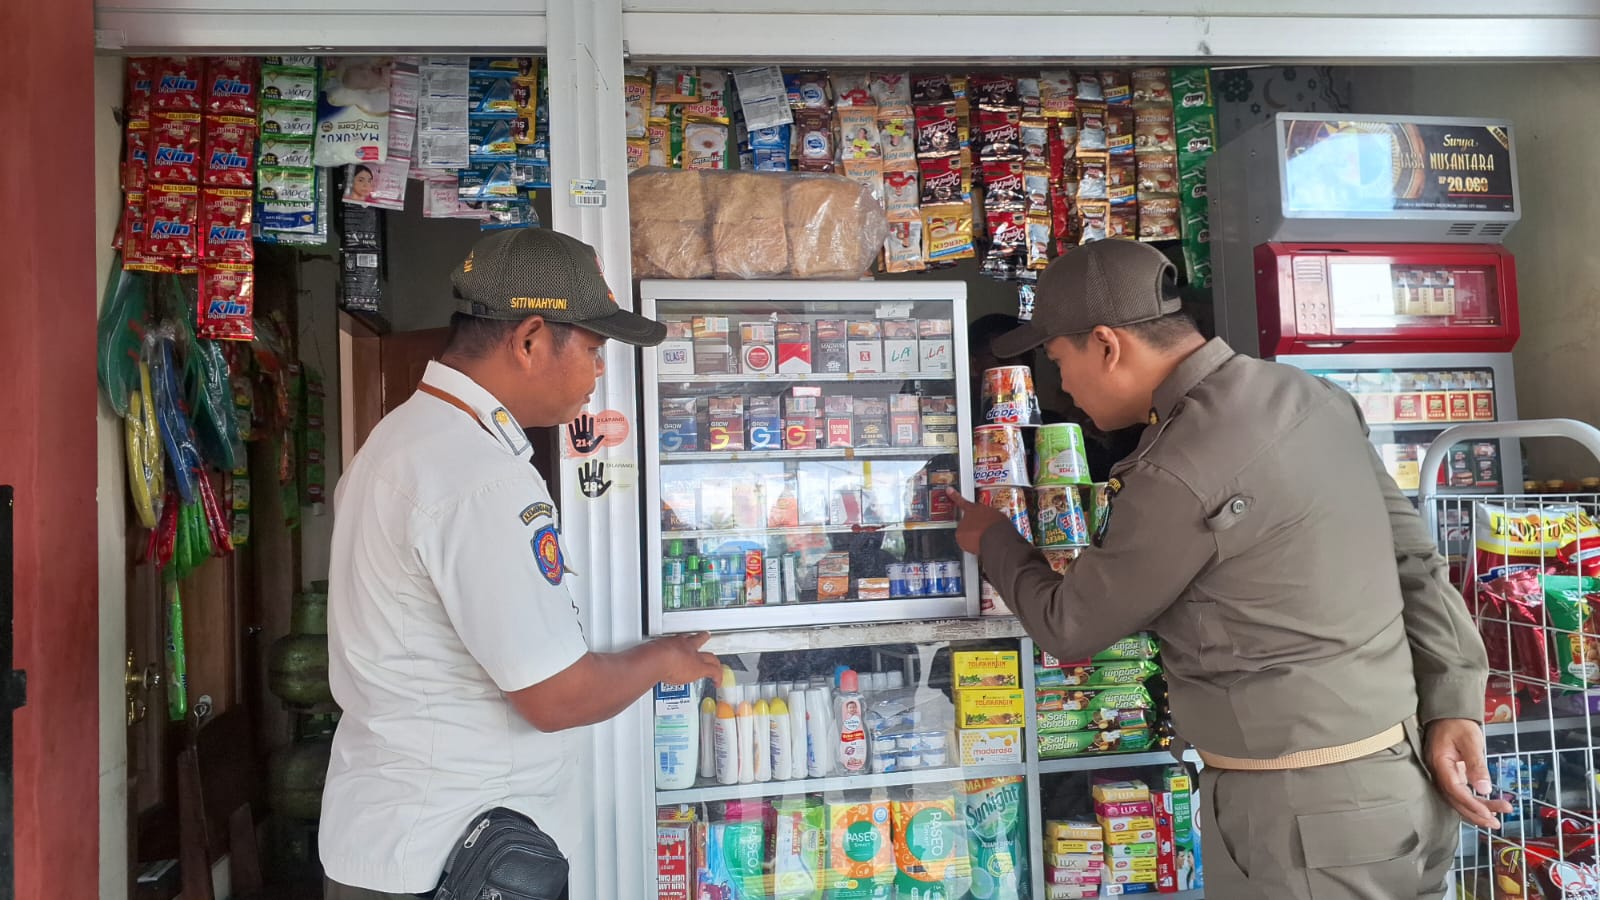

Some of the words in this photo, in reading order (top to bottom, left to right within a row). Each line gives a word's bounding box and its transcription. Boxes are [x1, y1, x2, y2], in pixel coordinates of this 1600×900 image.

[159, 75, 198, 91] Klin
[213, 79, 251, 95] Klin
[284, 122, 311, 131] Dove
[922, 125, 936, 138] Api
[935, 119, 958, 134] Kapal
[327, 132, 380, 143] MAKUKU
[1443, 134, 1475, 151] Surya
[155, 146, 194, 163] Klin
[210, 150, 248, 168] Klin
[1429, 153, 1495, 171] NUSANTARA
[925, 175, 938, 188] Api
[938, 171, 961, 186] Kapal
[989, 180, 1002, 191] Api
[1001, 175, 1021, 190] Kapal
[280, 188, 308, 198] Dove
[151, 220, 190, 235] Klin
[209, 225, 246, 241] Klin
[932, 237, 969, 250] ENERGEN
[208, 299, 247, 316] Klin
[891, 347, 912, 362] LA
[926, 345, 945, 360] LA
[575, 438, 594, 448] 21+
[583, 481, 604, 493] 18+
[1047, 711, 1068, 721] Sari
[1040, 718, 1078, 729] Gandum
[1040, 740, 1079, 751] Gandum
[1048, 735, 1068, 744] Sari
[966, 785, 1019, 830] Sunlight
[1120, 806, 1139, 814] LUX
[846, 831, 878, 843] PASEO
[929, 811, 944, 857] PASEO
[747, 825, 762, 868] PASEO
[1059, 858, 1077, 867] LUX
[1053, 891, 1071, 899] LUX
